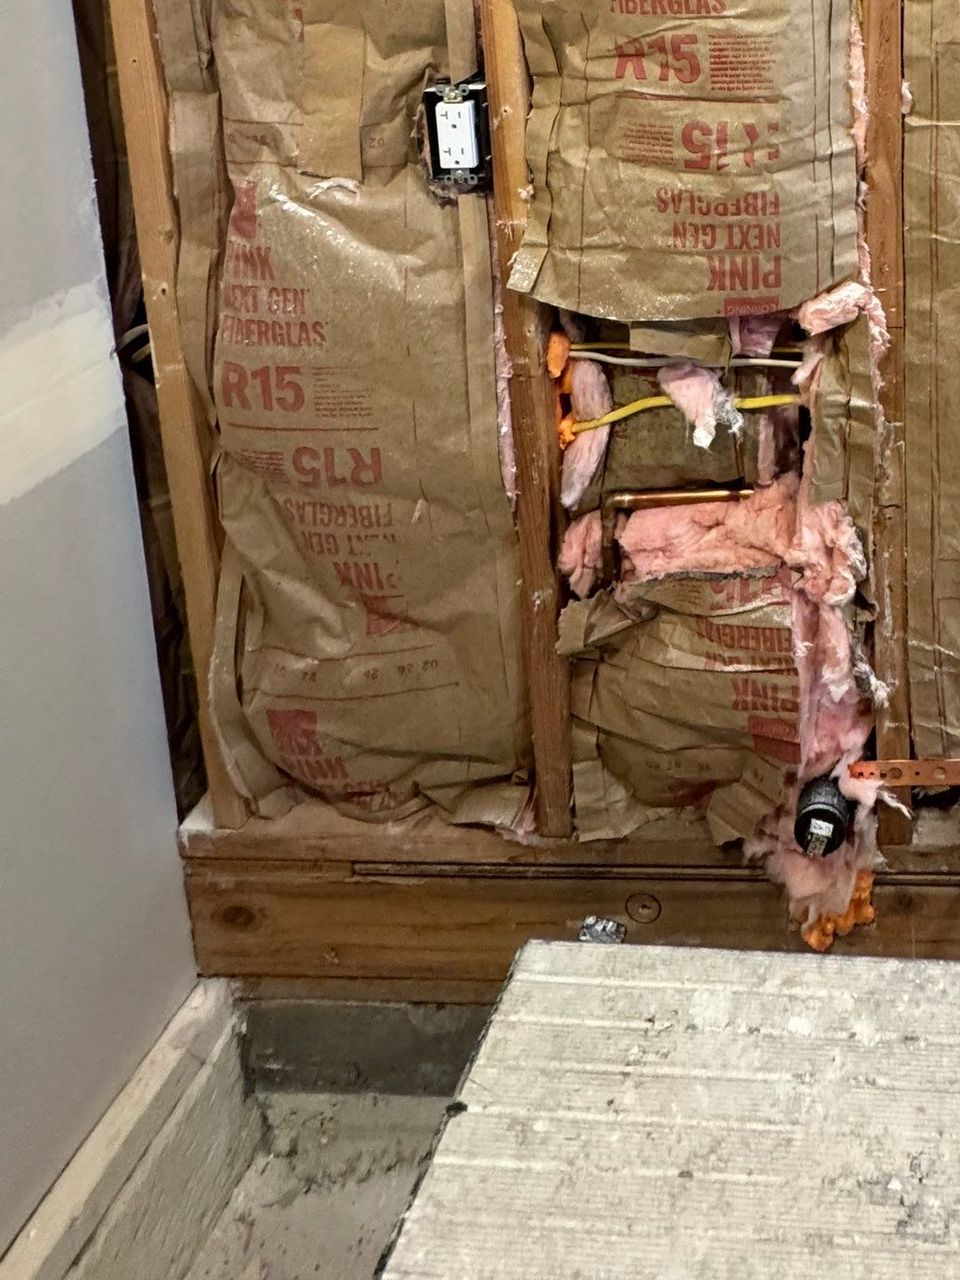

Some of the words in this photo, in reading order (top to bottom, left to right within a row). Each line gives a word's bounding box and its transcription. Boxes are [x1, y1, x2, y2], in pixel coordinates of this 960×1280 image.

[614, 32, 701, 84] R15
[672, 221, 717, 250] GEN
[725, 222, 781, 251] NEXT
[706, 254, 782, 291] PINK
[267, 287, 307, 315] GEN
[222, 361, 305, 413] R15
[292, 446, 384, 488] R15
[303, 531, 341, 556] GEN
